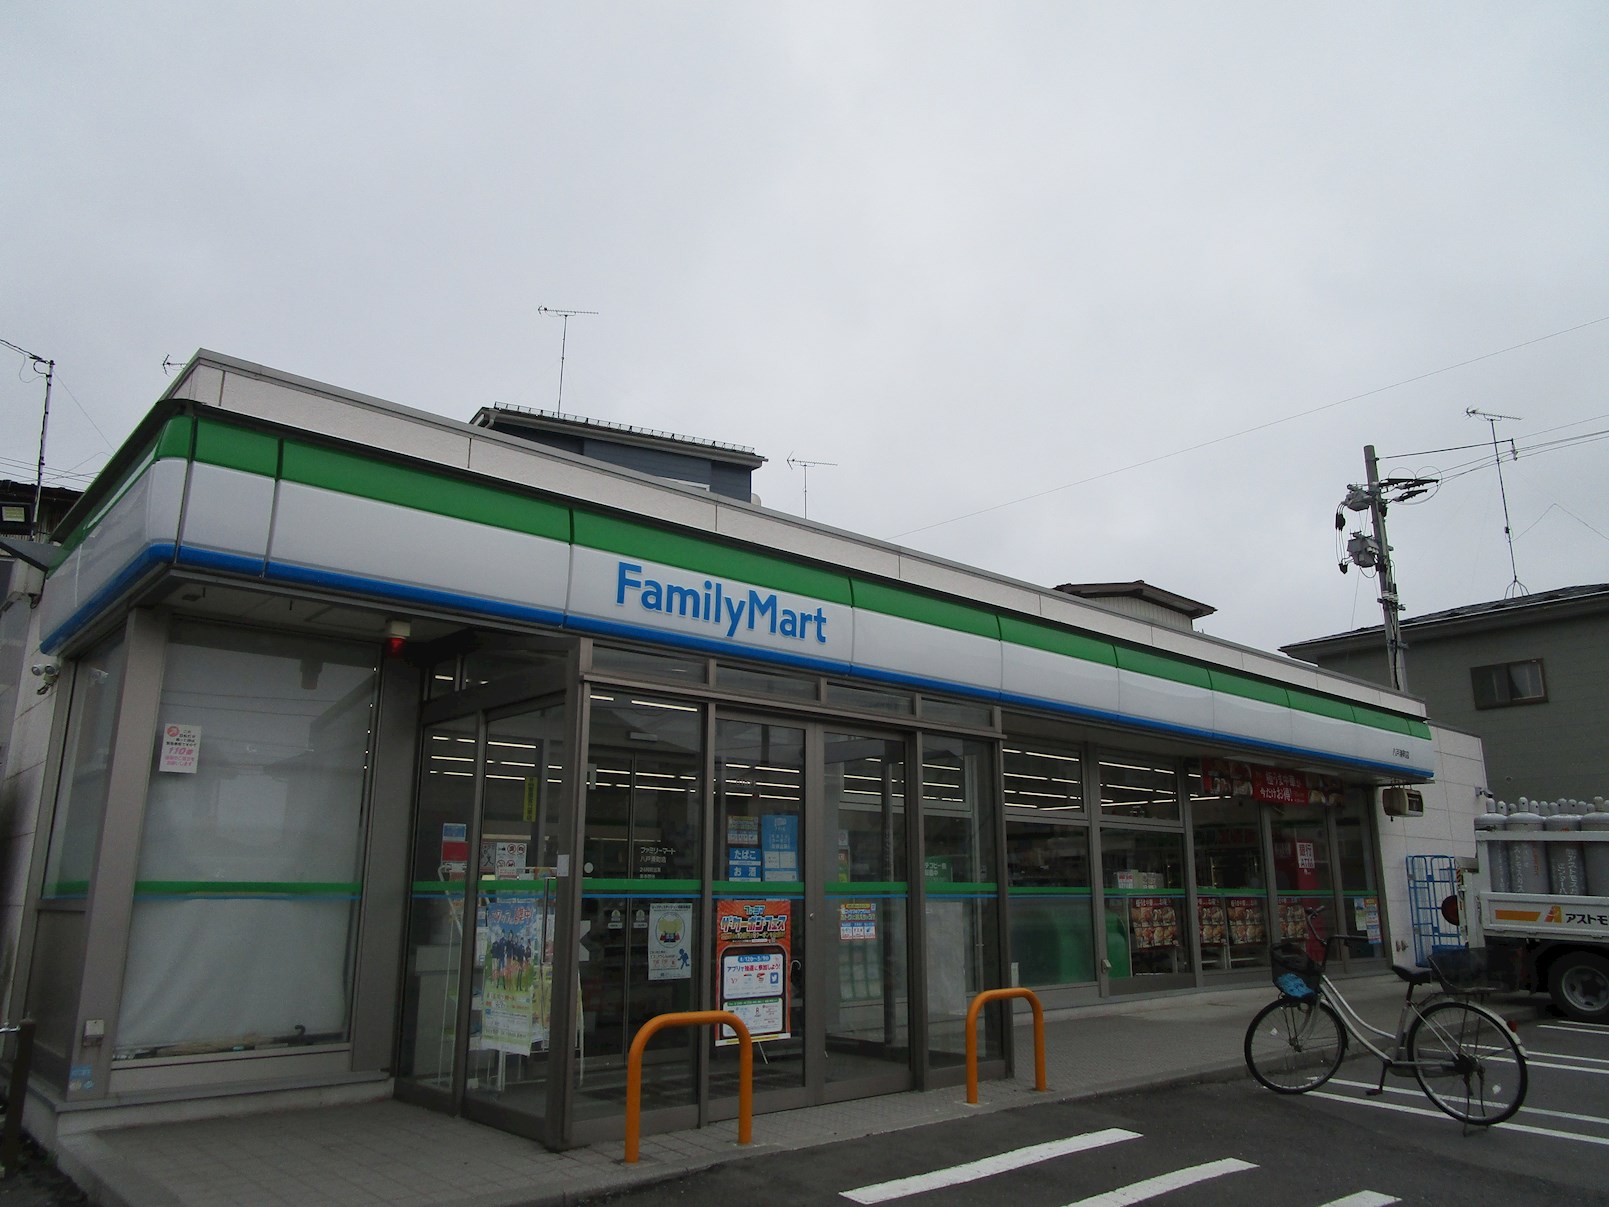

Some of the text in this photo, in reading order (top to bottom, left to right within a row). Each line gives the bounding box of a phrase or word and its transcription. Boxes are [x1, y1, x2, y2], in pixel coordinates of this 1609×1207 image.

[615, 561, 827, 643] FamilyMart
[640, 846, 677, 855] ファミリーマート
[734, 849, 757, 860] たばこ
[1299, 844, 1312, 857] 銀行
[733, 866, 757, 877] お酒
[743, 904, 766, 916] ファミマ
[1565, 913, 1609, 926] アストモ
